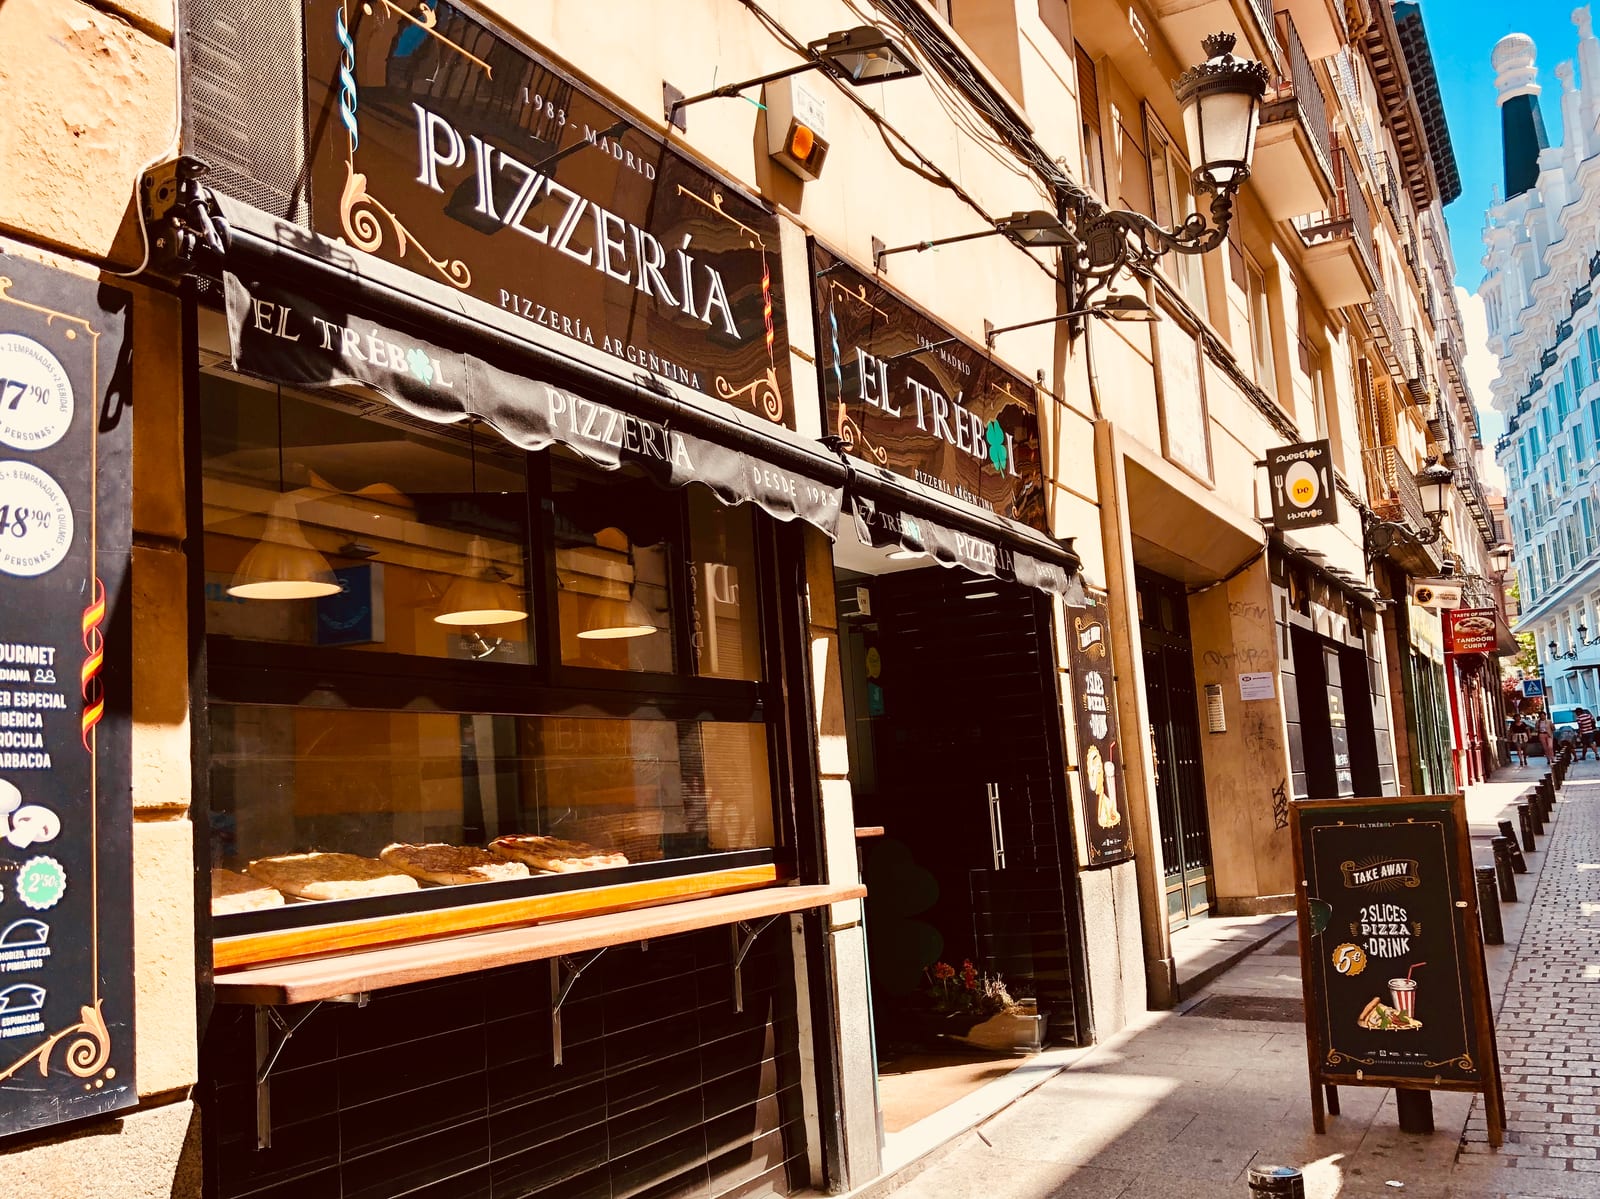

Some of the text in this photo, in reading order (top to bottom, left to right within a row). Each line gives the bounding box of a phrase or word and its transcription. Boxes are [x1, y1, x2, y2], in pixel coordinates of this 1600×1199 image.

[522, 87, 567, 126] 1983
[584, 124, 656, 181] MADRID
[411, 102, 742, 340] PIZZERÍA
[251, 297, 300, 341] EL
[499, 288, 701, 390] PIZZERÍA ARGENTINA
[940, 348, 971, 376] MADRID
[855, 346, 901, 418] EL
[5, 426, 51, 441] PERSONAS
[544, 386, 839, 507] PIZZERÍA DESDE 1983
[914, 468, 951, 495] PIZZERÍA
[5, 550, 51, 566] PERSONAS
[954, 532, 1015, 572] PIZZERÍA
[1457, 636, 1494, 644] TANDOORI
[13, 692, 67, 709] ESPECIAL
[1353, 863, 1408, 884] TAKE AWAY
[1360, 907, 1368, 922] 2
[1361, 923, 1411, 935] PIZZA
[2, 1012, 40, 1027] ESPINACAS
[3, 1023, 45, 1038] PARMESANO
